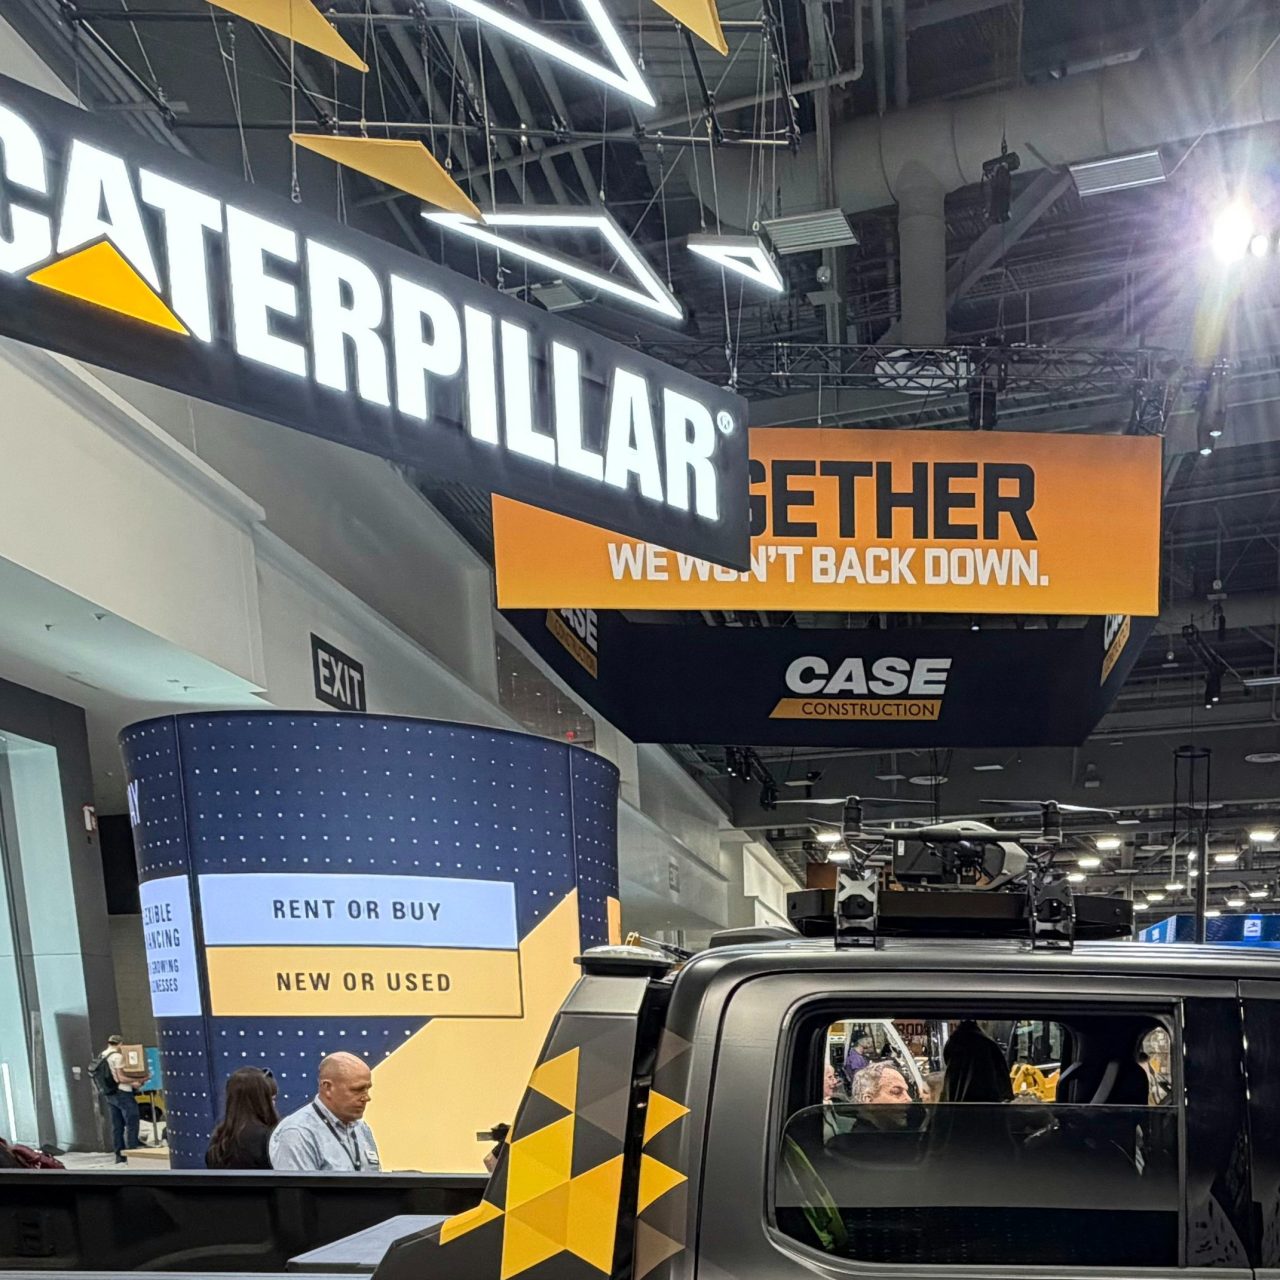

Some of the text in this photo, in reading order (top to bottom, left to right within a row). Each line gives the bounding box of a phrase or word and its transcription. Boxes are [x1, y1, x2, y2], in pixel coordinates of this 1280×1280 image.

[608, 543, 669, 580] WE
[812, 546, 917, 584] BACK
[925, 547, 1049, 586] DOWN.
[317, 648, 362, 711] EXIT
[785, 655, 952, 695] CASE
[801, 702, 935, 717] CONSTRUCTION
[273, 899, 441, 921] RENT OR BUY
[276, 972, 451, 992] NEW OR USED
